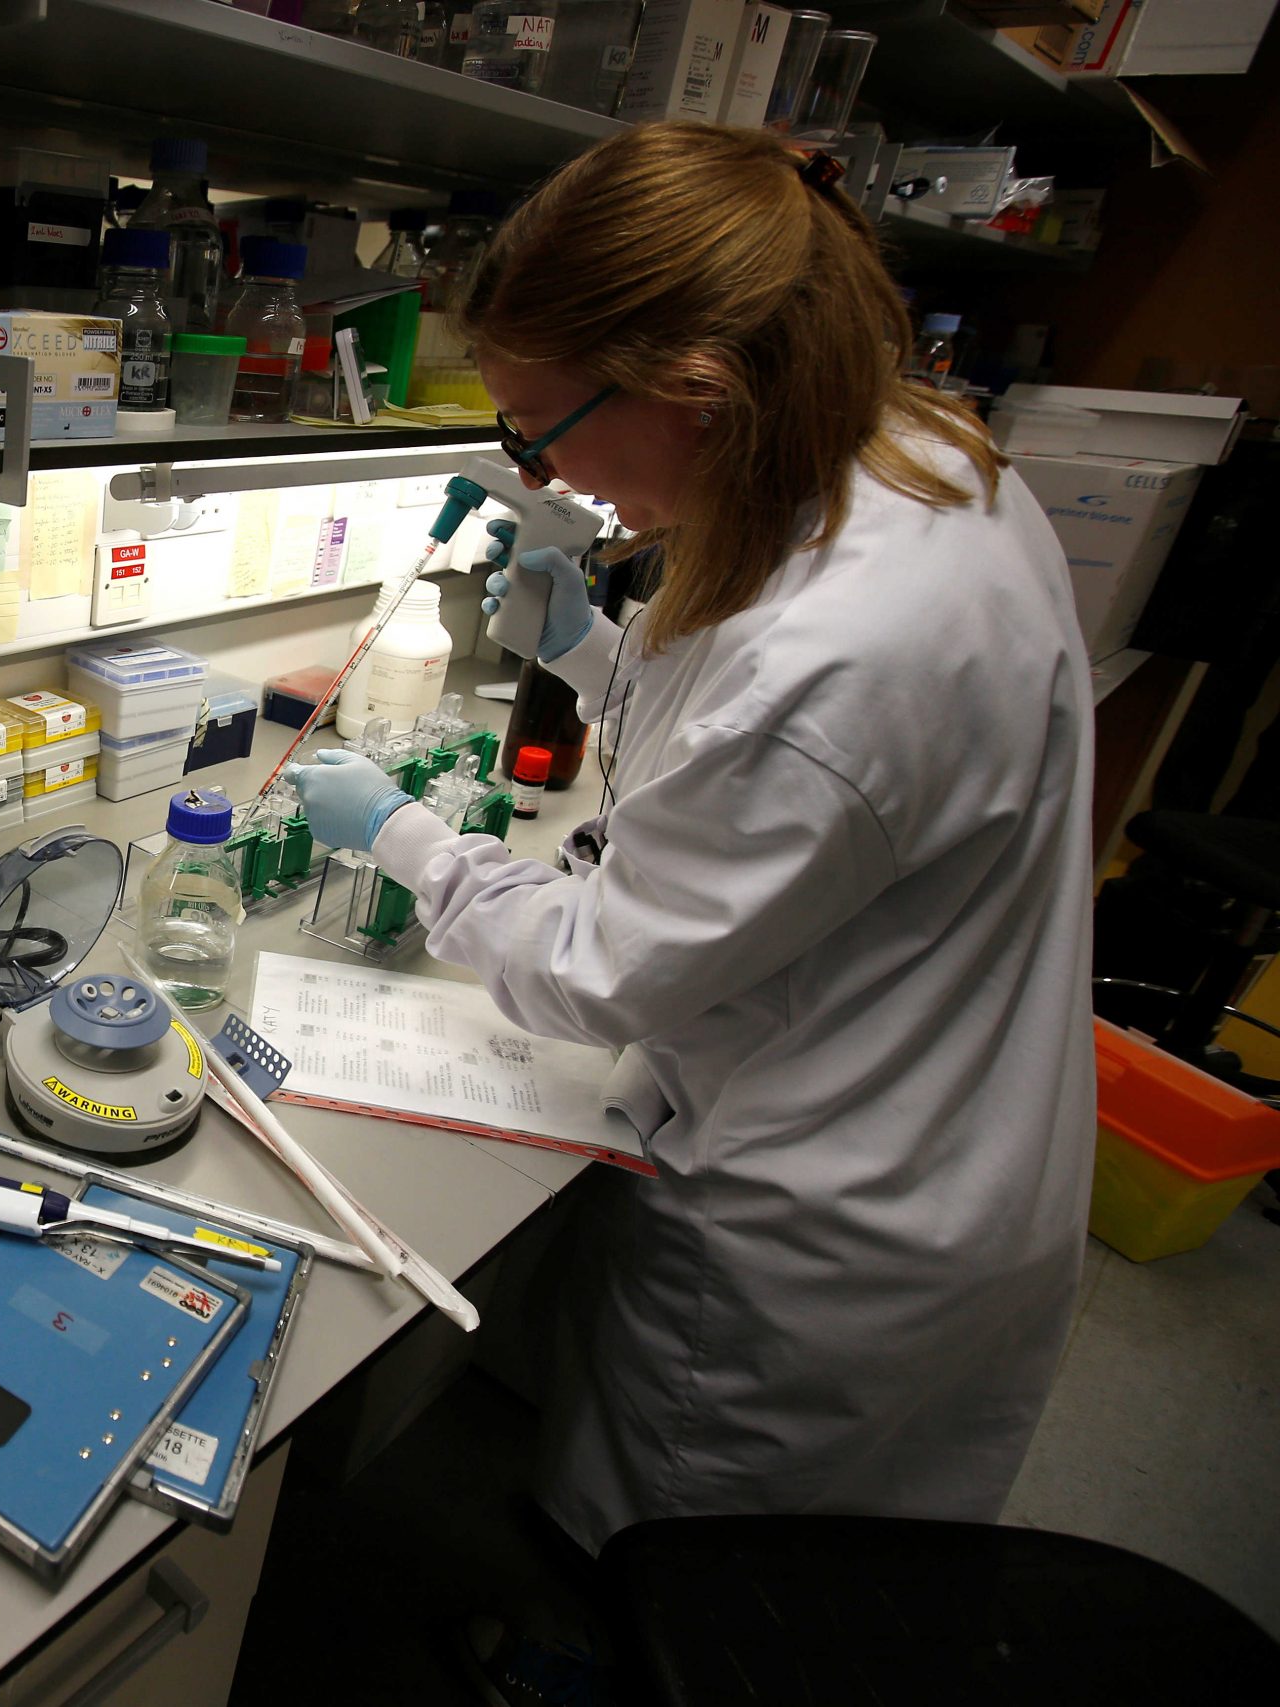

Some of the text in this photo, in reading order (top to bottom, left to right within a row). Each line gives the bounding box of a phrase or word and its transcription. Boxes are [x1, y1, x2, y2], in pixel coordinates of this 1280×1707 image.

[522, 18, 551, 33] NAT
[12, 333, 77, 350] XCEED
[83, 336, 117, 350] NITRILE
[130, 353, 144, 361] 250
[1124, 474, 1169, 491] CELLS
[120, 548, 139, 559] GA-W
[116, 566, 142, 577] 151 152
[261, 1004, 282, 1035] KATY
[57, 1087, 133, 1119] WARNING
[81, 1243, 97, 1257] 13
[72, 1251, 92, 1268] RAY
[166, 1426, 208, 1448] SSETTE
[165, 1438, 183, 1455] 18
